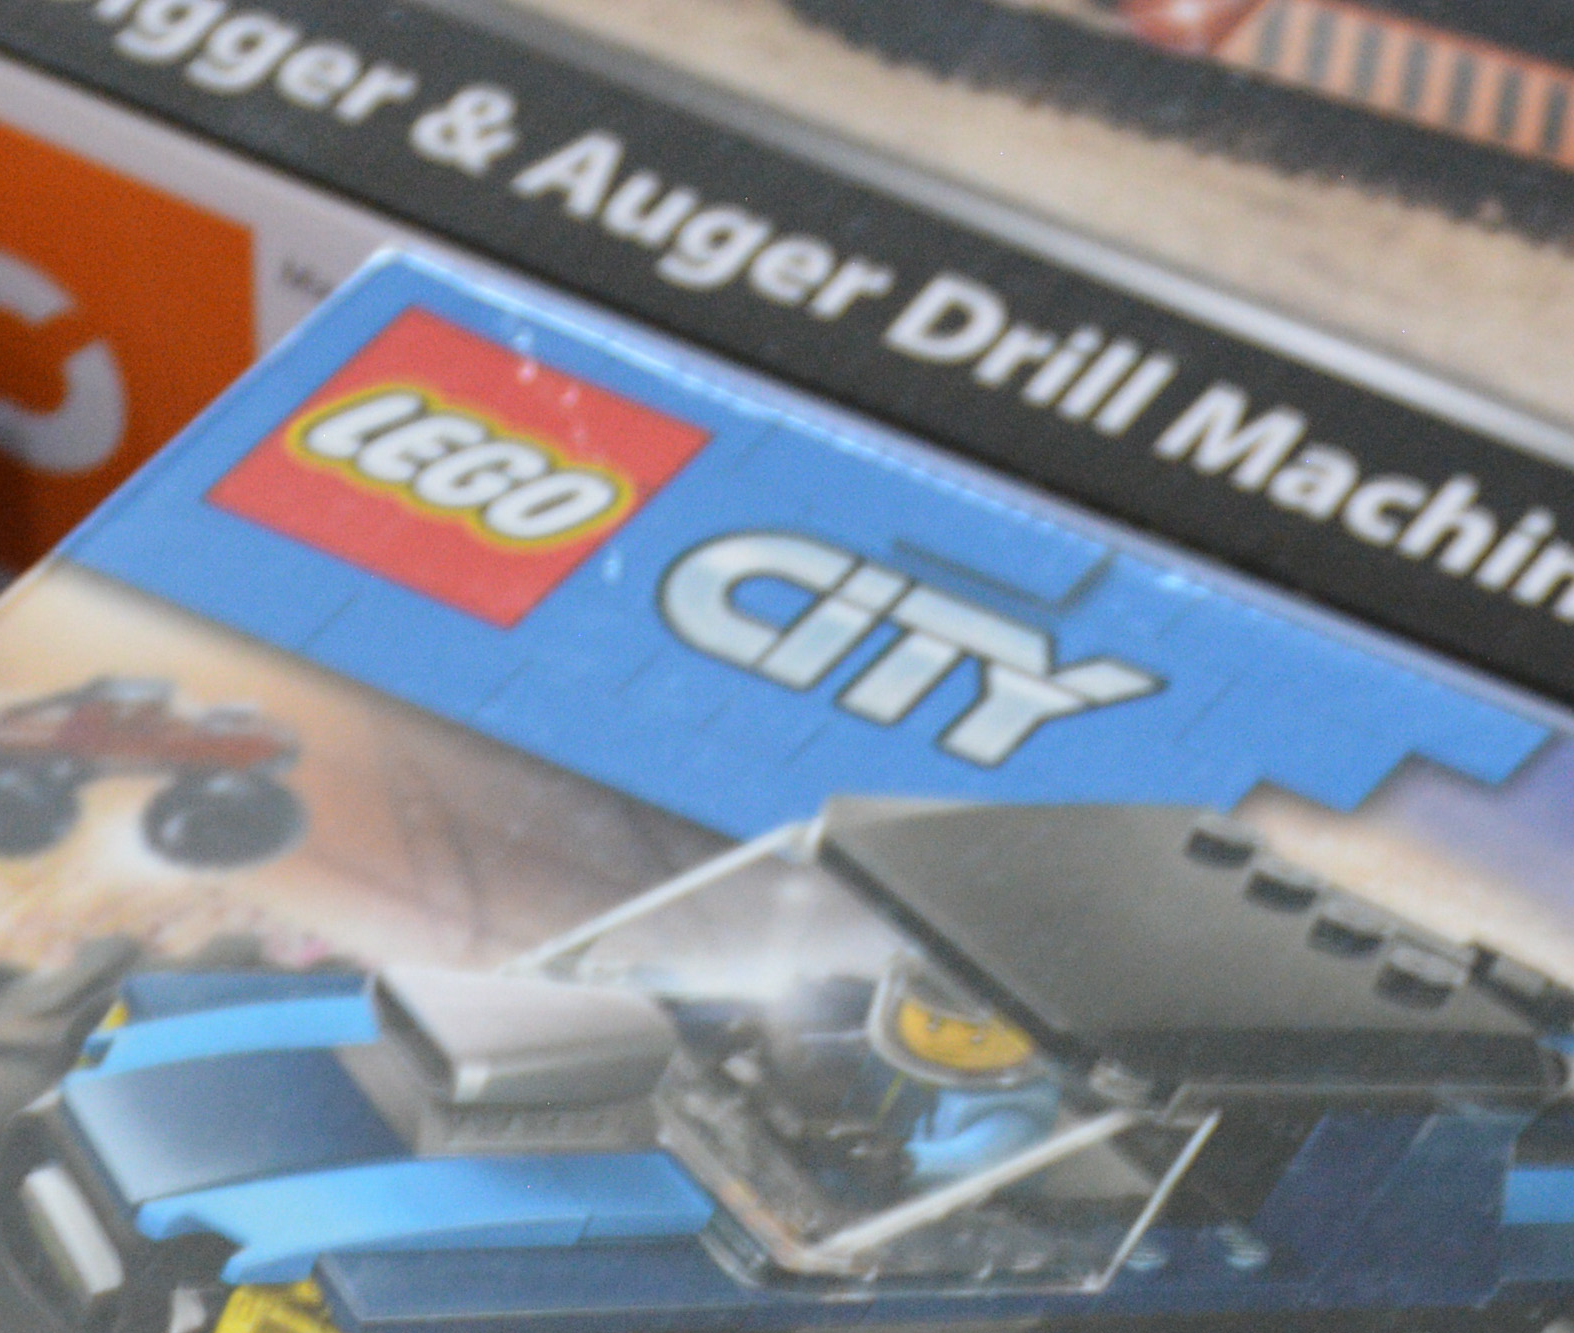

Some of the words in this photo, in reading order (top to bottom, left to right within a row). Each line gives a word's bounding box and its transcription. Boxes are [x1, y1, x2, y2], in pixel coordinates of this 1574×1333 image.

[409, 84, 526, 178] &
[515, 131, 893, 319] Auger
[882, 272, 1178, 436] Drill
[291, 384, 630, 550] LEGO
